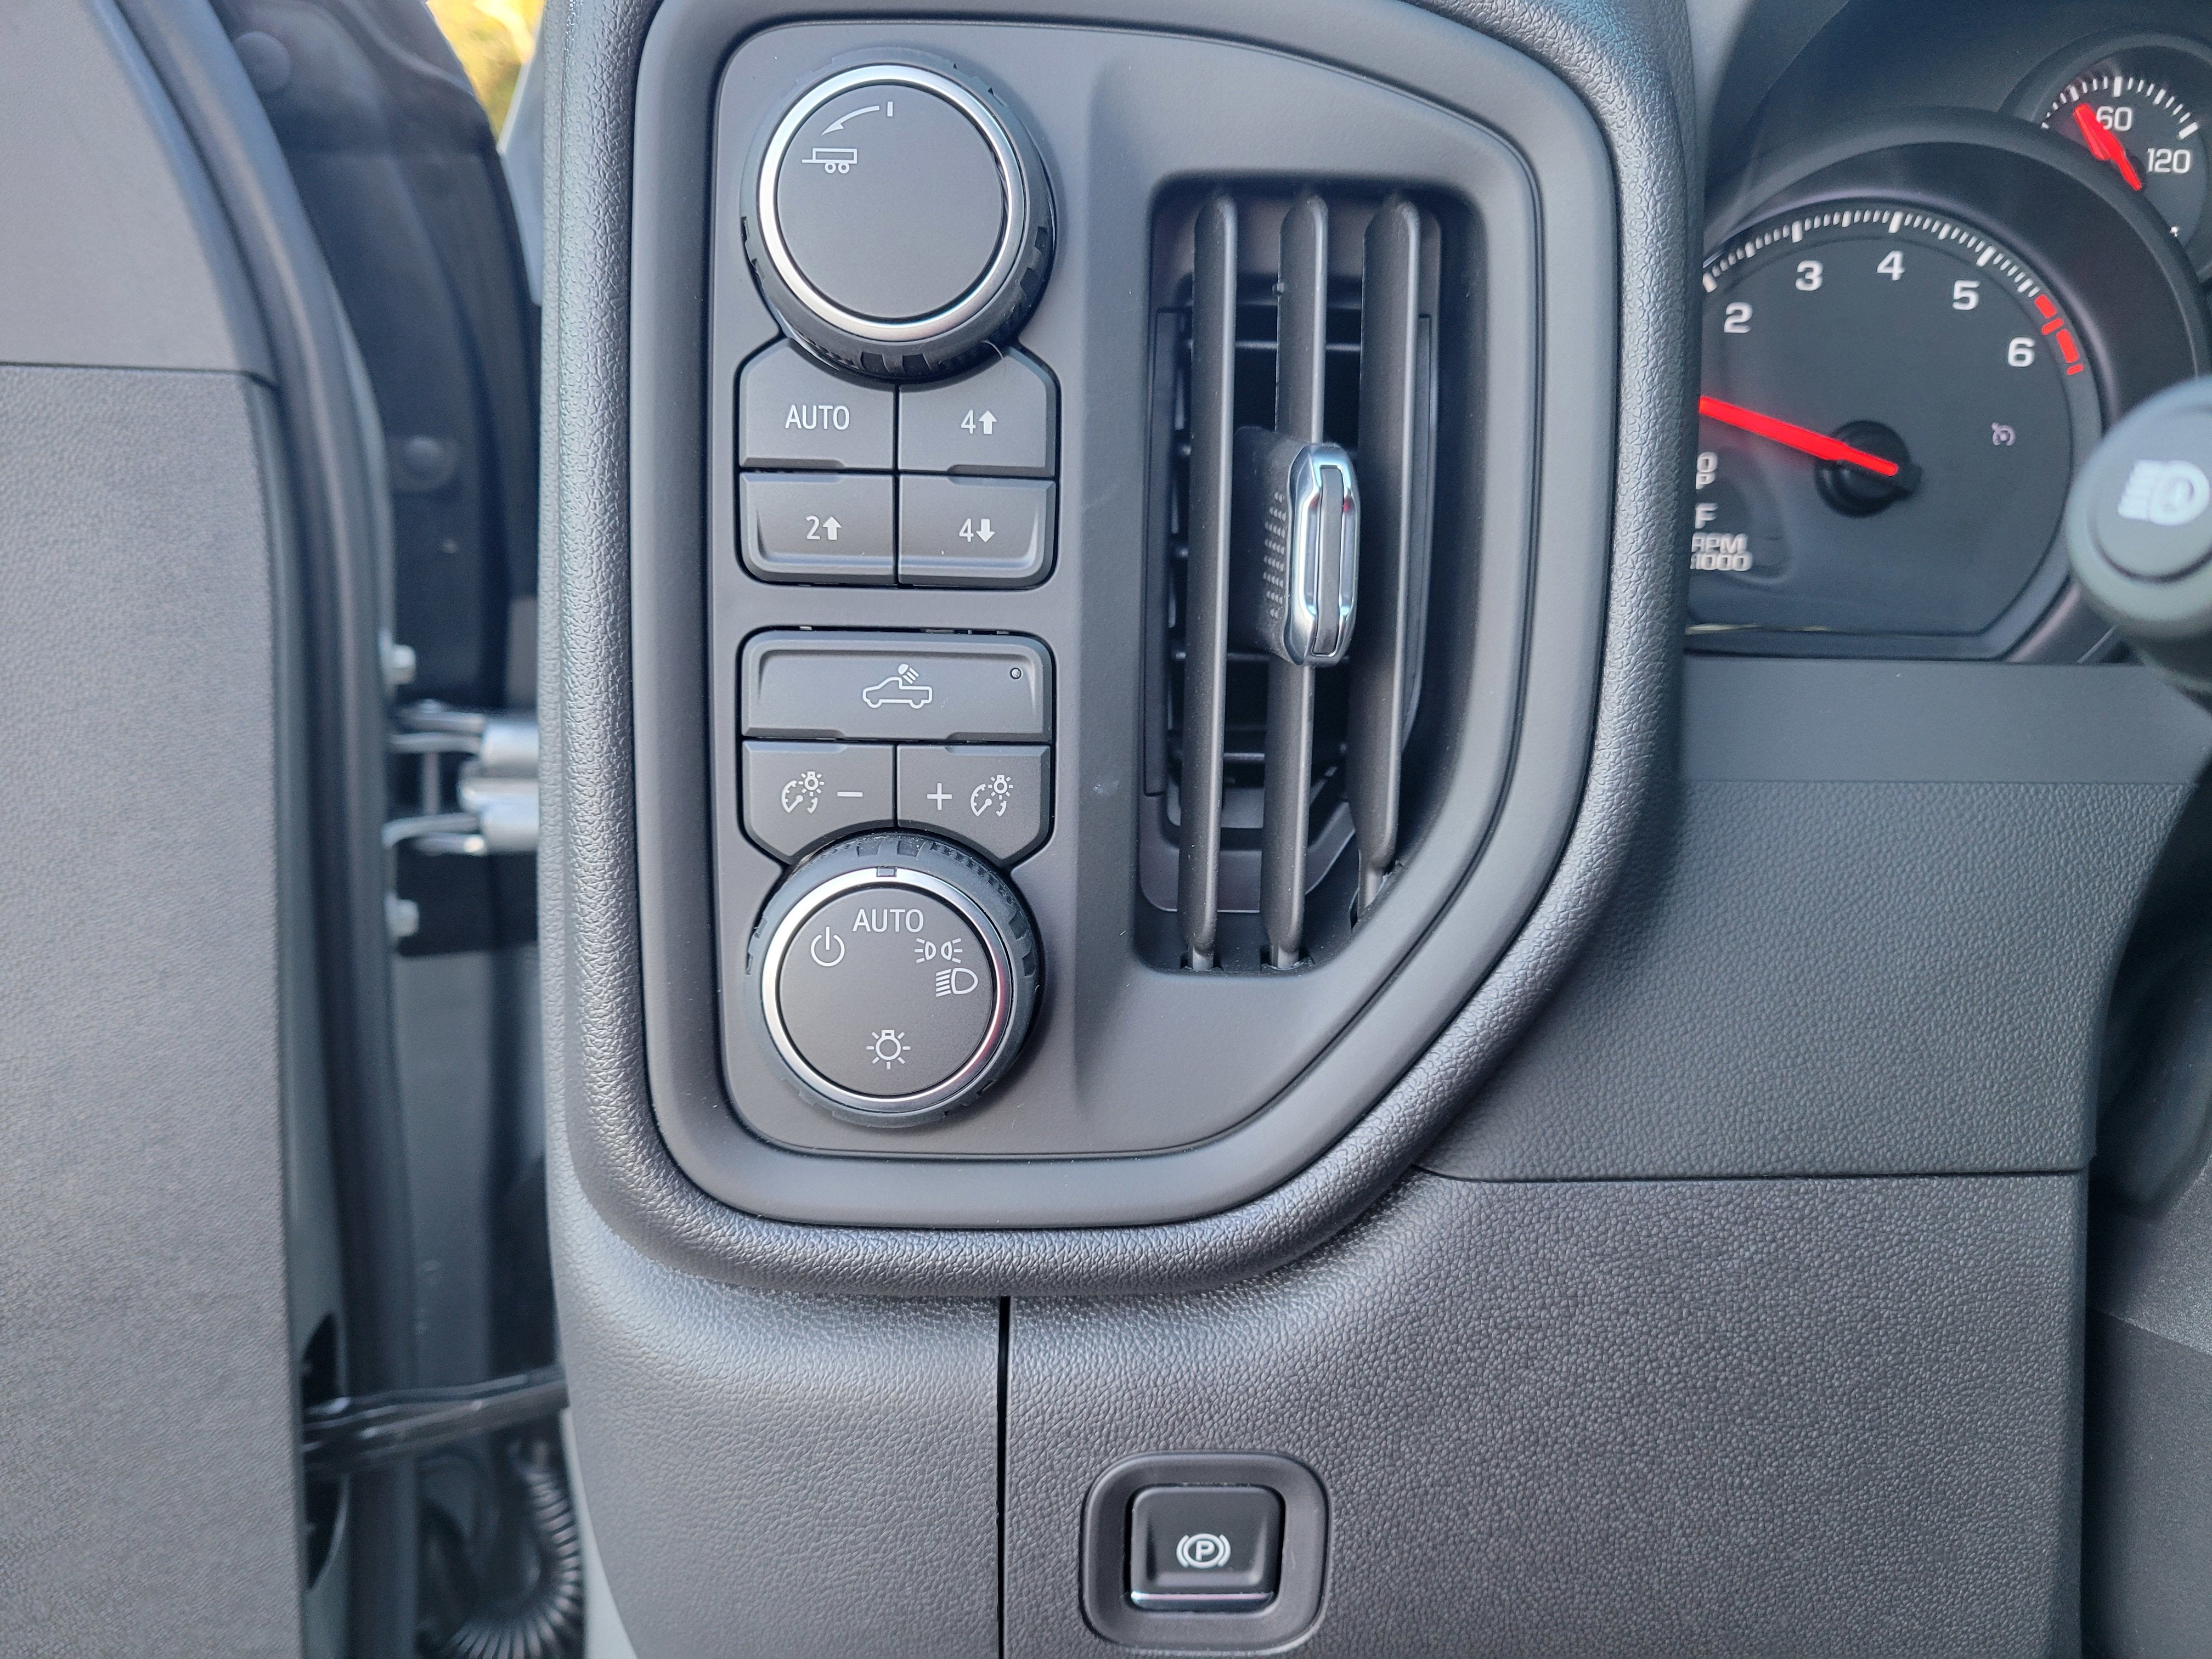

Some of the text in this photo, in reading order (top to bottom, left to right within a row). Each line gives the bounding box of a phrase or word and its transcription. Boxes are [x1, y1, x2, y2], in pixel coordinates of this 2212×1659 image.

[2096, 105, 2133, 132] 60
[2147, 148, 2191, 174] 120
[1795, 260, 1823, 291] 3
[1876, 251, 1904, 281] 4
[1952, 280, 1980, 311] 5
[1723, 302, 1752, 334] 2
[2007, 337, 2035, 368] 6
[785, 404, 850, 431] AUTO
[960, 409, 977, 435] 4
[805, 515, 821, 540] 2
[958, 518, 974, 543] 4
[852, 908, 924, 933] AUTO
